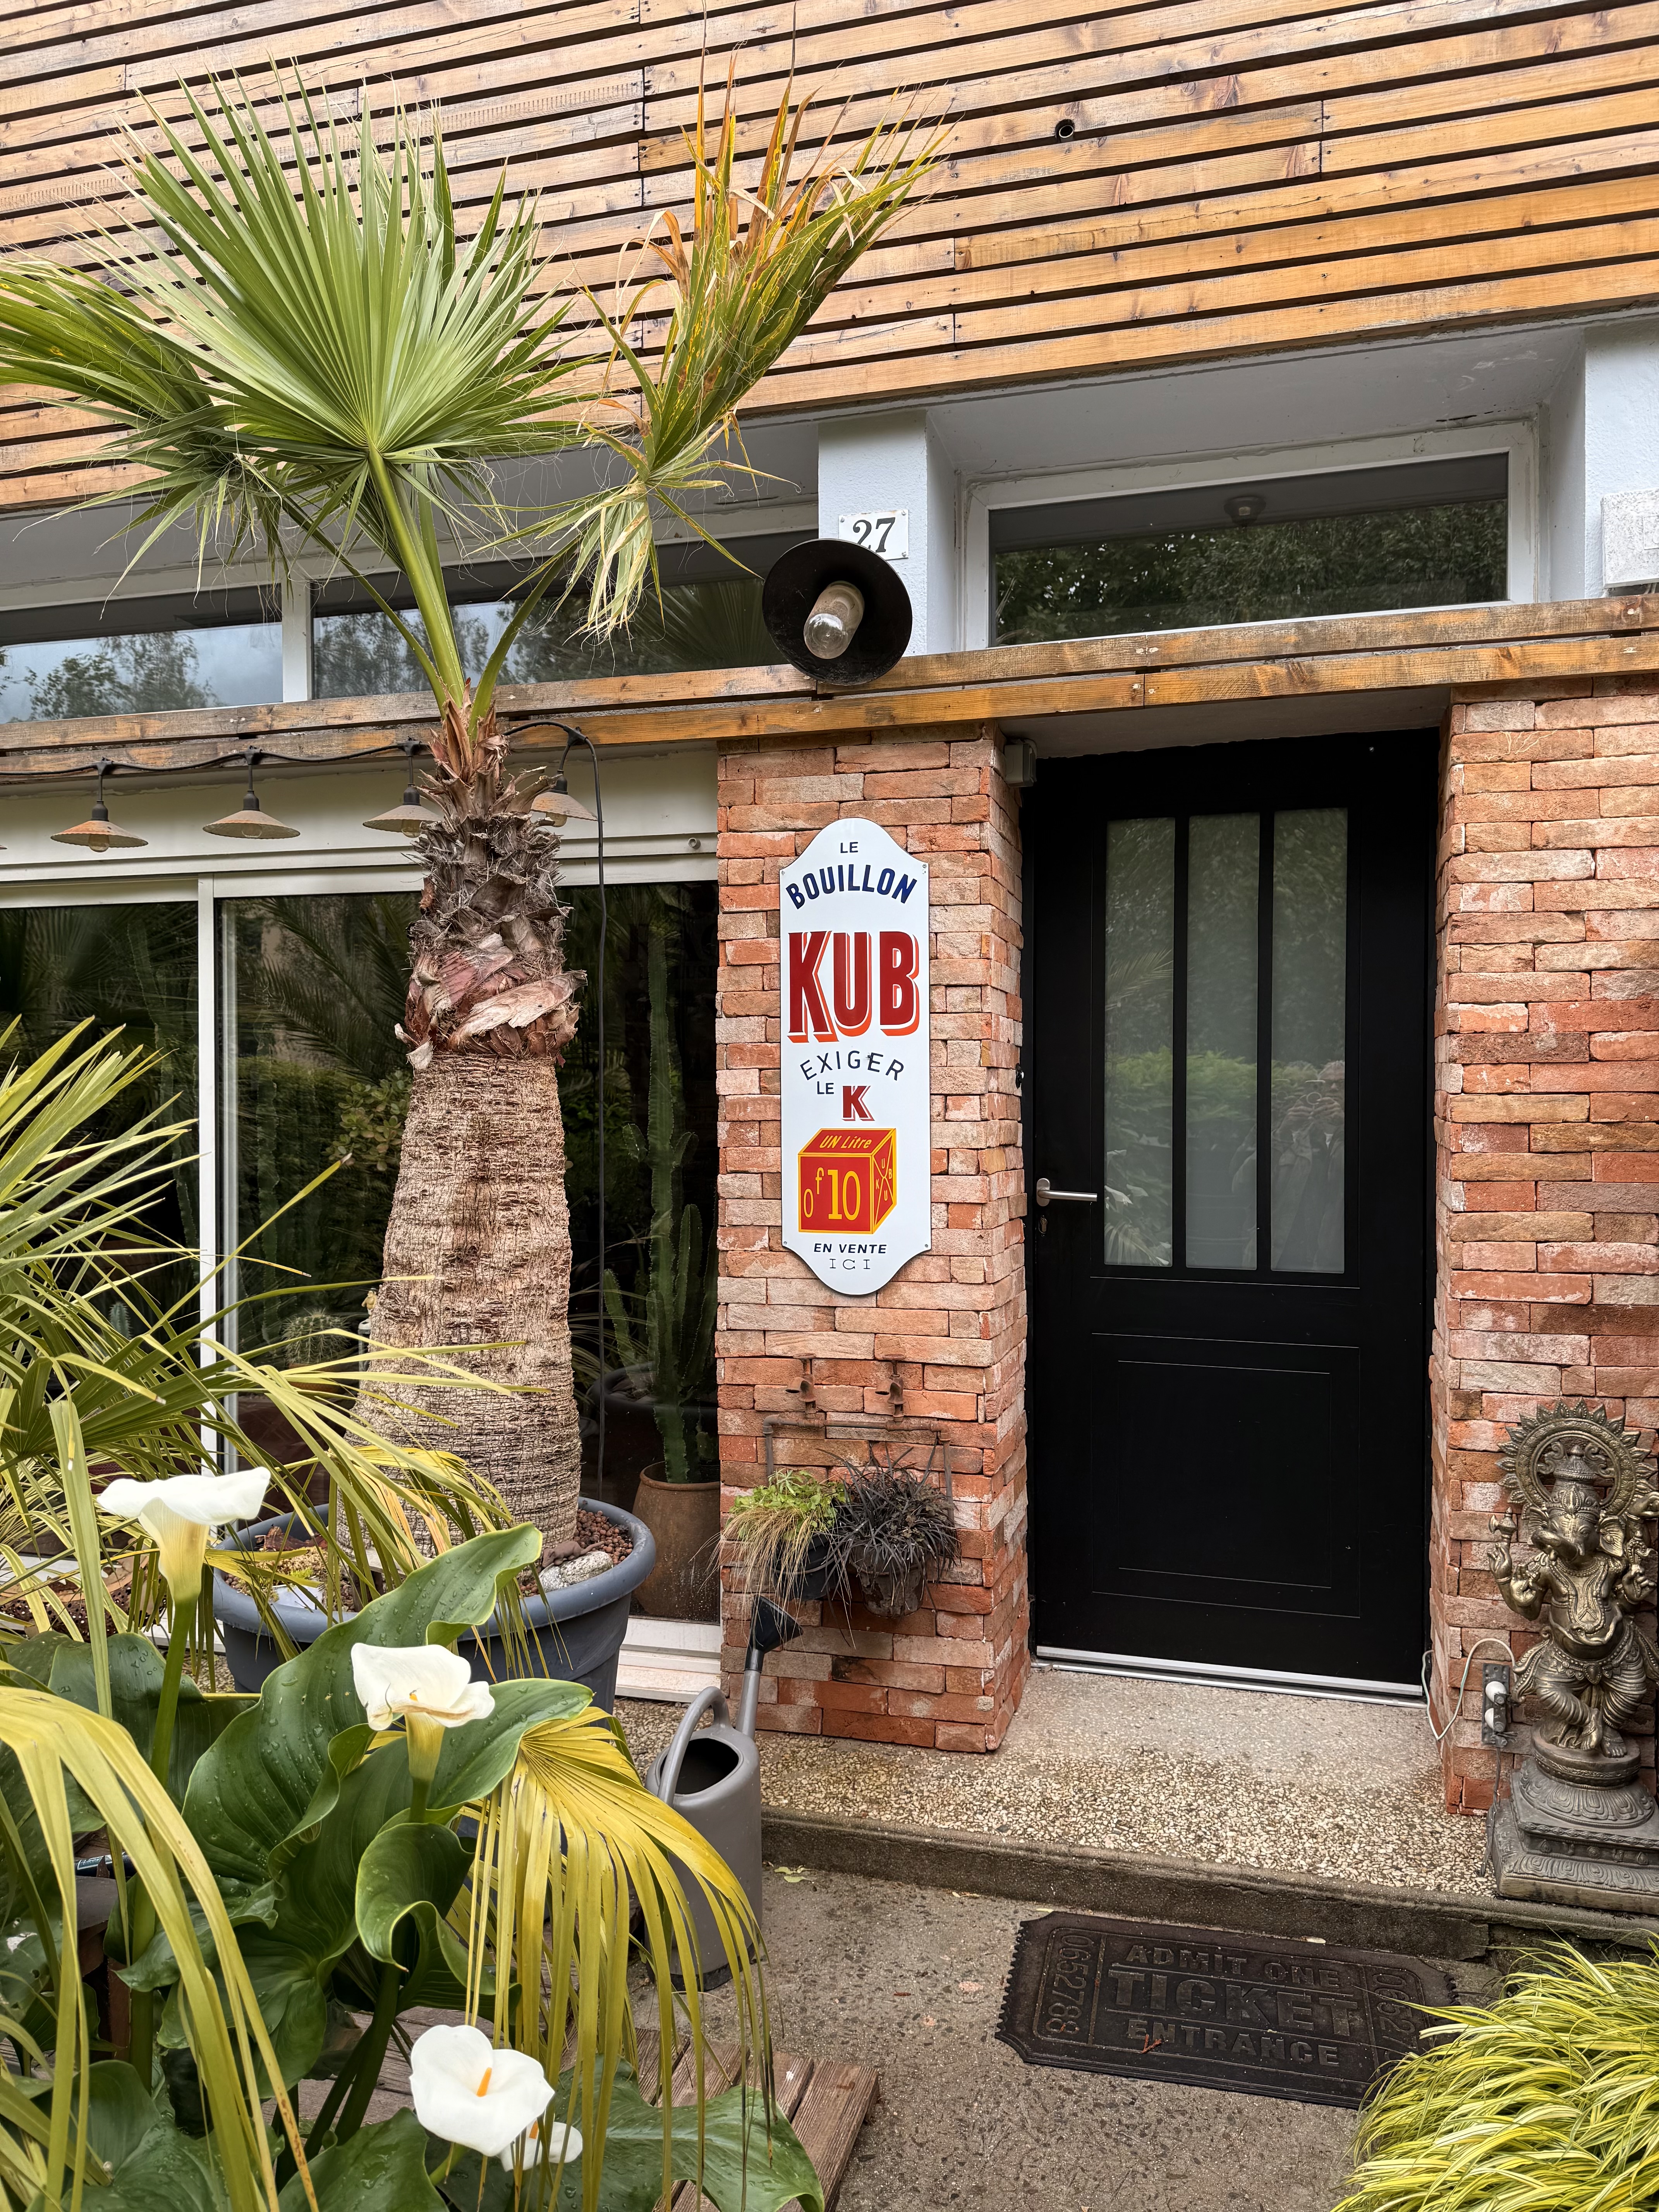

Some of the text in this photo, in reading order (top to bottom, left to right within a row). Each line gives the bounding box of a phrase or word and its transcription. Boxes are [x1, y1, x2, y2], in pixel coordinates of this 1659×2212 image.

[853, 517, 895, 553] 27
[840, 842, 859, 854] LE
[785, 864, 917, 910] BOUILLON
[787, 931, 919, 1043] KUB
[800, 1050, 904, 1081] EXIGER
[817, 1081, 875, 1121] LE K
[819, 1135, 872, 1149] UN Litre
[814, 1243, 887, 1254] EN VENTE
[829, 1259, 871, 1270] ICI
[1046, 1935, 1094, 2035] 0652788
[1125, 1945, 1340, 1988] ADMIT ONE
[1108, 1969, 1358, 2036] TICKET
[1127, 2019, 1340, 2066] ENTRANCE
[1373, 1973, 1419, 2078] 06527
